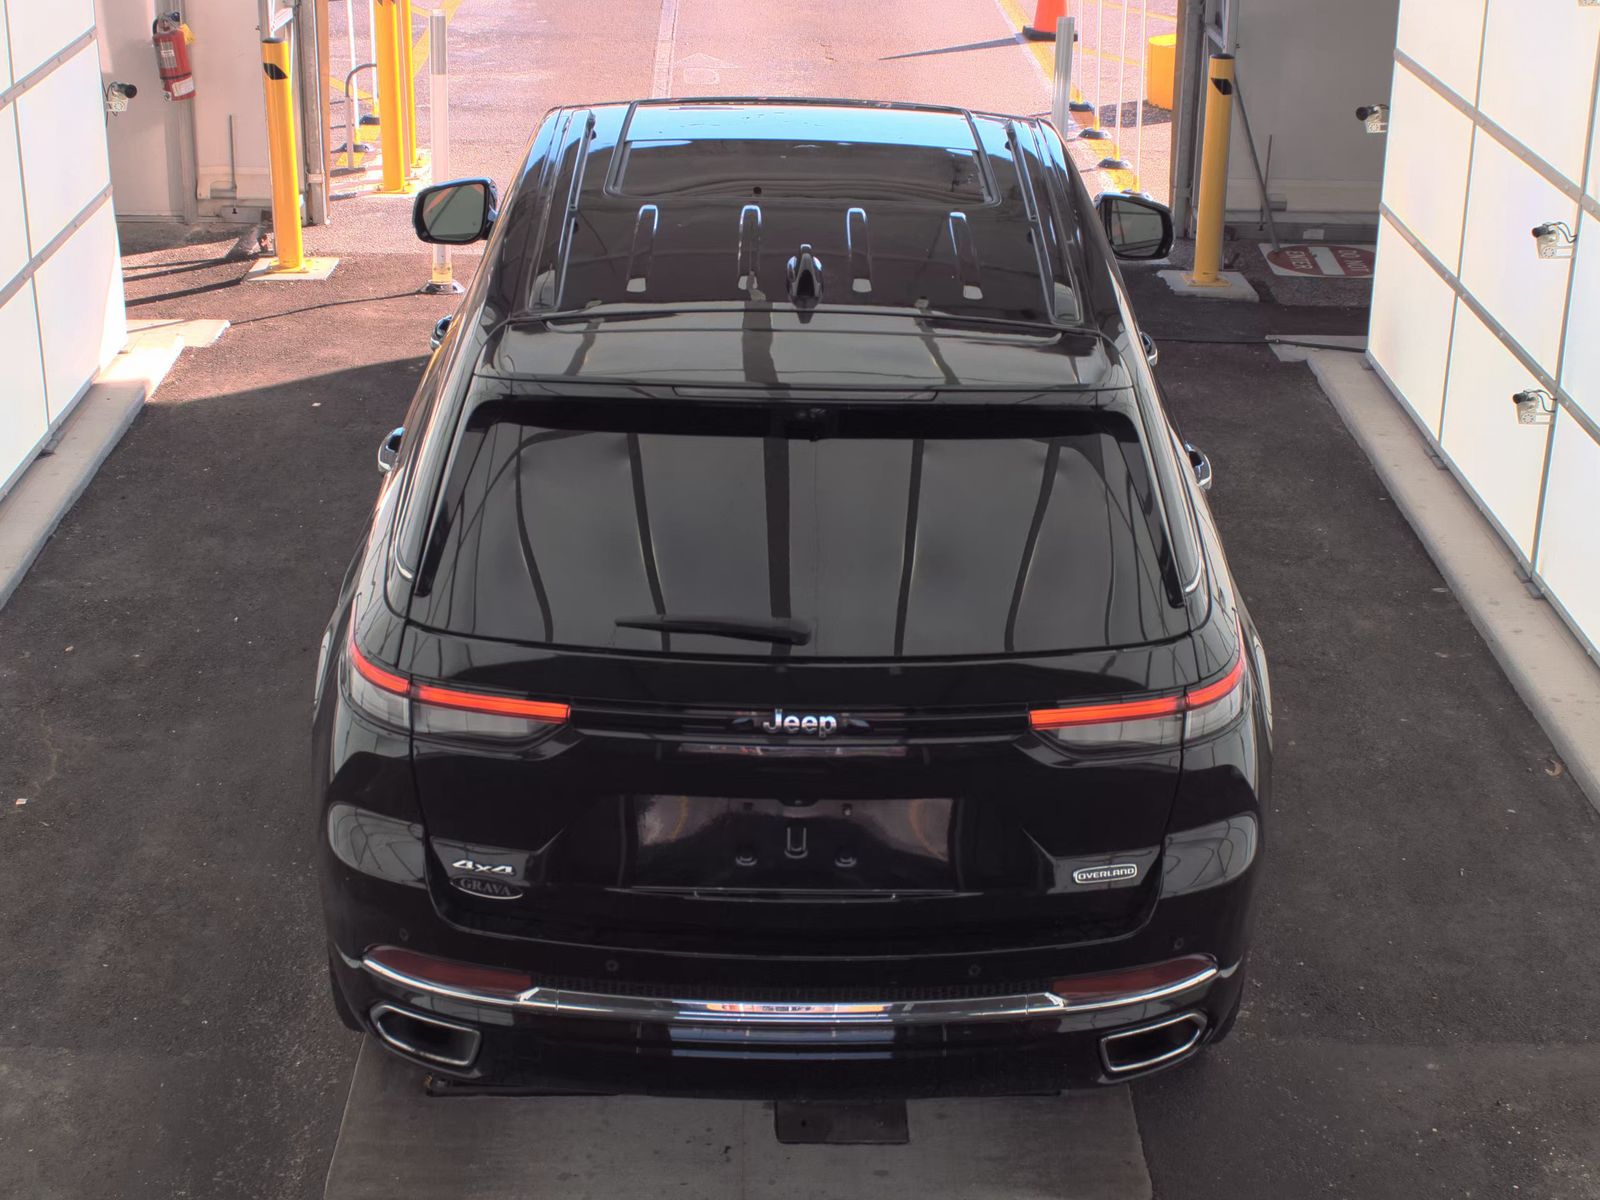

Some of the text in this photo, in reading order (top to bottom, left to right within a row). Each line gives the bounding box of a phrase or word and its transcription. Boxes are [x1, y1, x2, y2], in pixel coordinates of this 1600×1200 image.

[1286, 250, 1313, 269] ENTER
[1338, 249, 1369, 272] DO NOT
[762, 708, 838, 738] Jeep
[1078, 867, 1135, 880] OVERLAND
[460, 878, 511, 896] GRAVA
